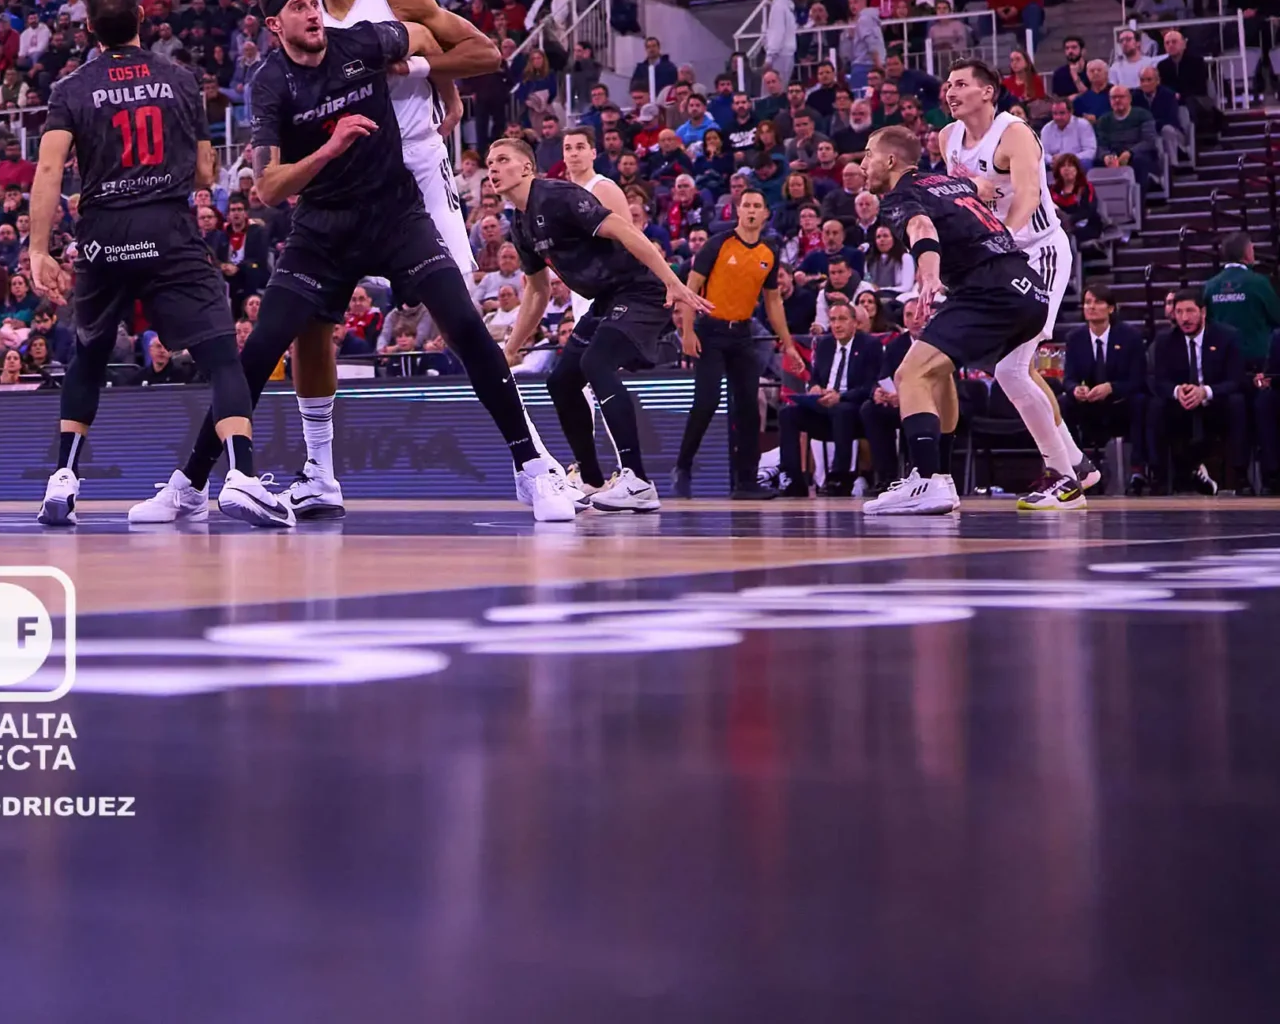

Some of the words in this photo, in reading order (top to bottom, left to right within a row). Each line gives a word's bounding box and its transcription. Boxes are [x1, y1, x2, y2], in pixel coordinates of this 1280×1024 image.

[108, 64, 151, 82] COSTA
[92, 83, 174, 108] PULEVA
[112, 105, 165, 168] 10
[104, 240, 156, 254] Diputación
[119, 249, 160, 261] Granada
